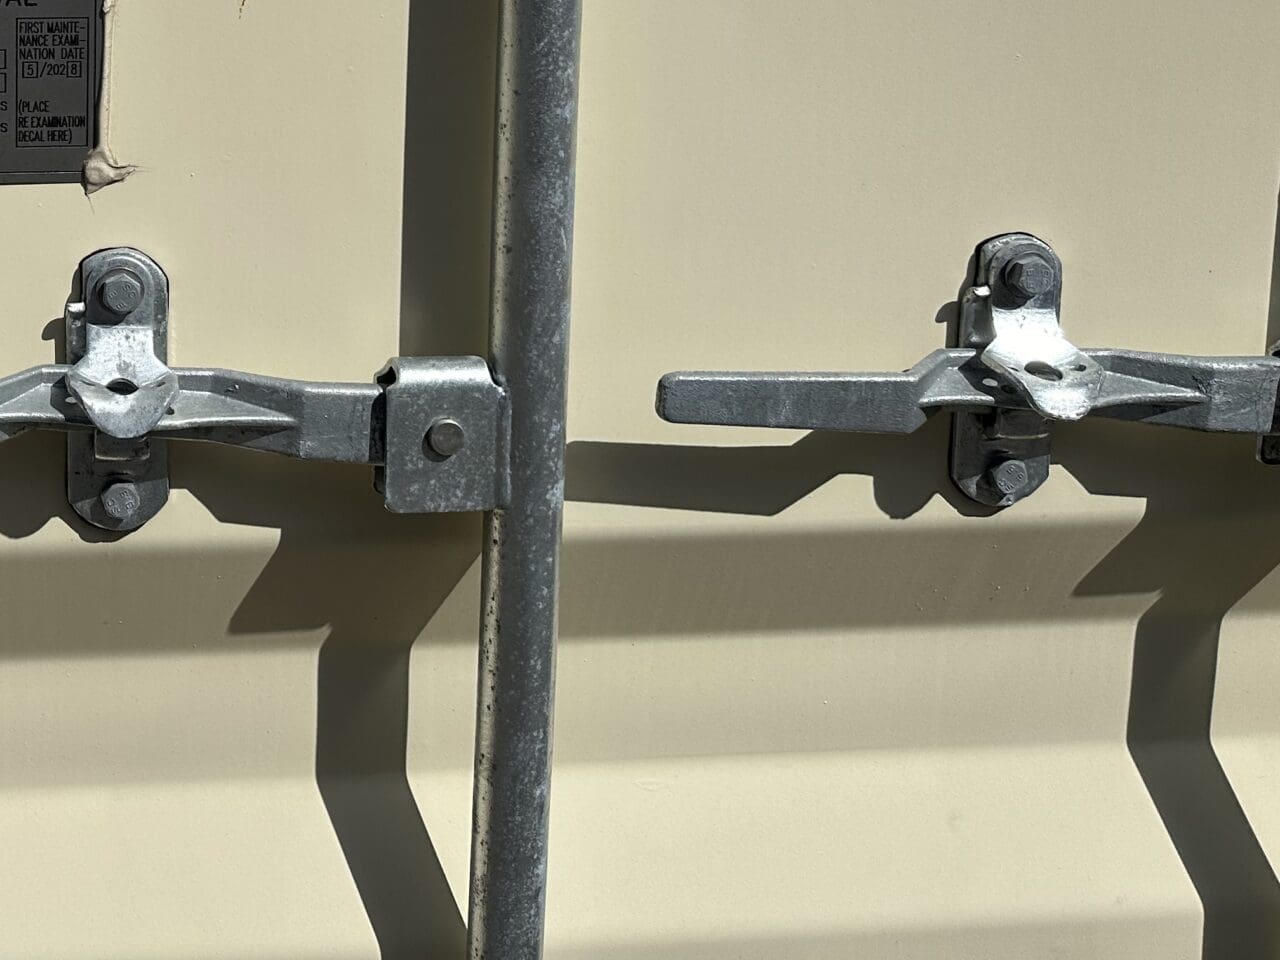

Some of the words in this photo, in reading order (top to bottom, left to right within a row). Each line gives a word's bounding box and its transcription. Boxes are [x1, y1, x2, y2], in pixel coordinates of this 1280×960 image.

[19, 22, 44, 34] FIRST
[20, 34, 50, 46] NANCE
[20, 48, 56, 60] NATION
[60, 47, 85, 60] DATE
[18, 99, 50, 116] (PLACE
[18, 129, 45, 142] DECAL
[47, 128, 73, 144] HERE)
